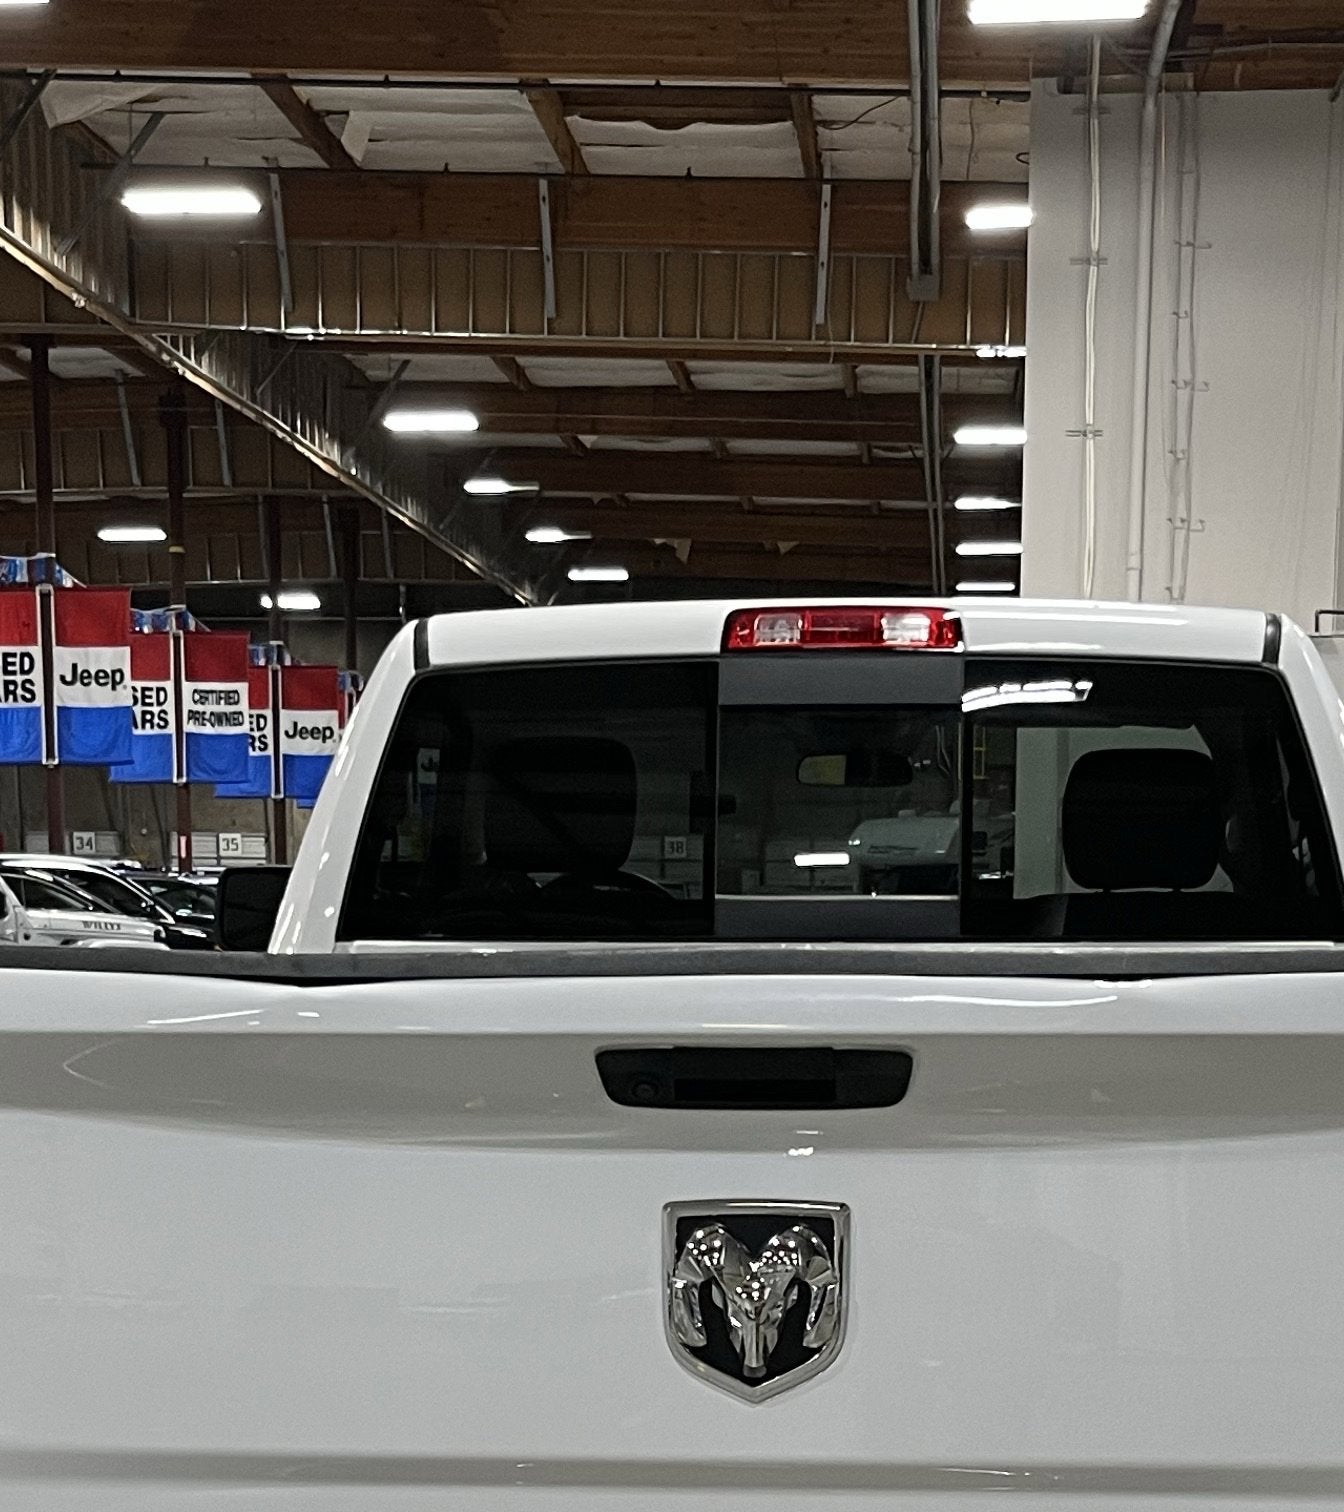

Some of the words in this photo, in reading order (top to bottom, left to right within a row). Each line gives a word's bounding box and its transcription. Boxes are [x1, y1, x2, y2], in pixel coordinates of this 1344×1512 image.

[60, 662, 124, 691] Jeep
[131, 686, 168, 707] SED
[192, 688, 240, 706] CERTIFIED
[187, 709, 245, 728] PRE-OWNED
[284, 721, 335, 743] Jeep
[76, 836, 94, 850] 34
[222, 837, 239, 851] 35
